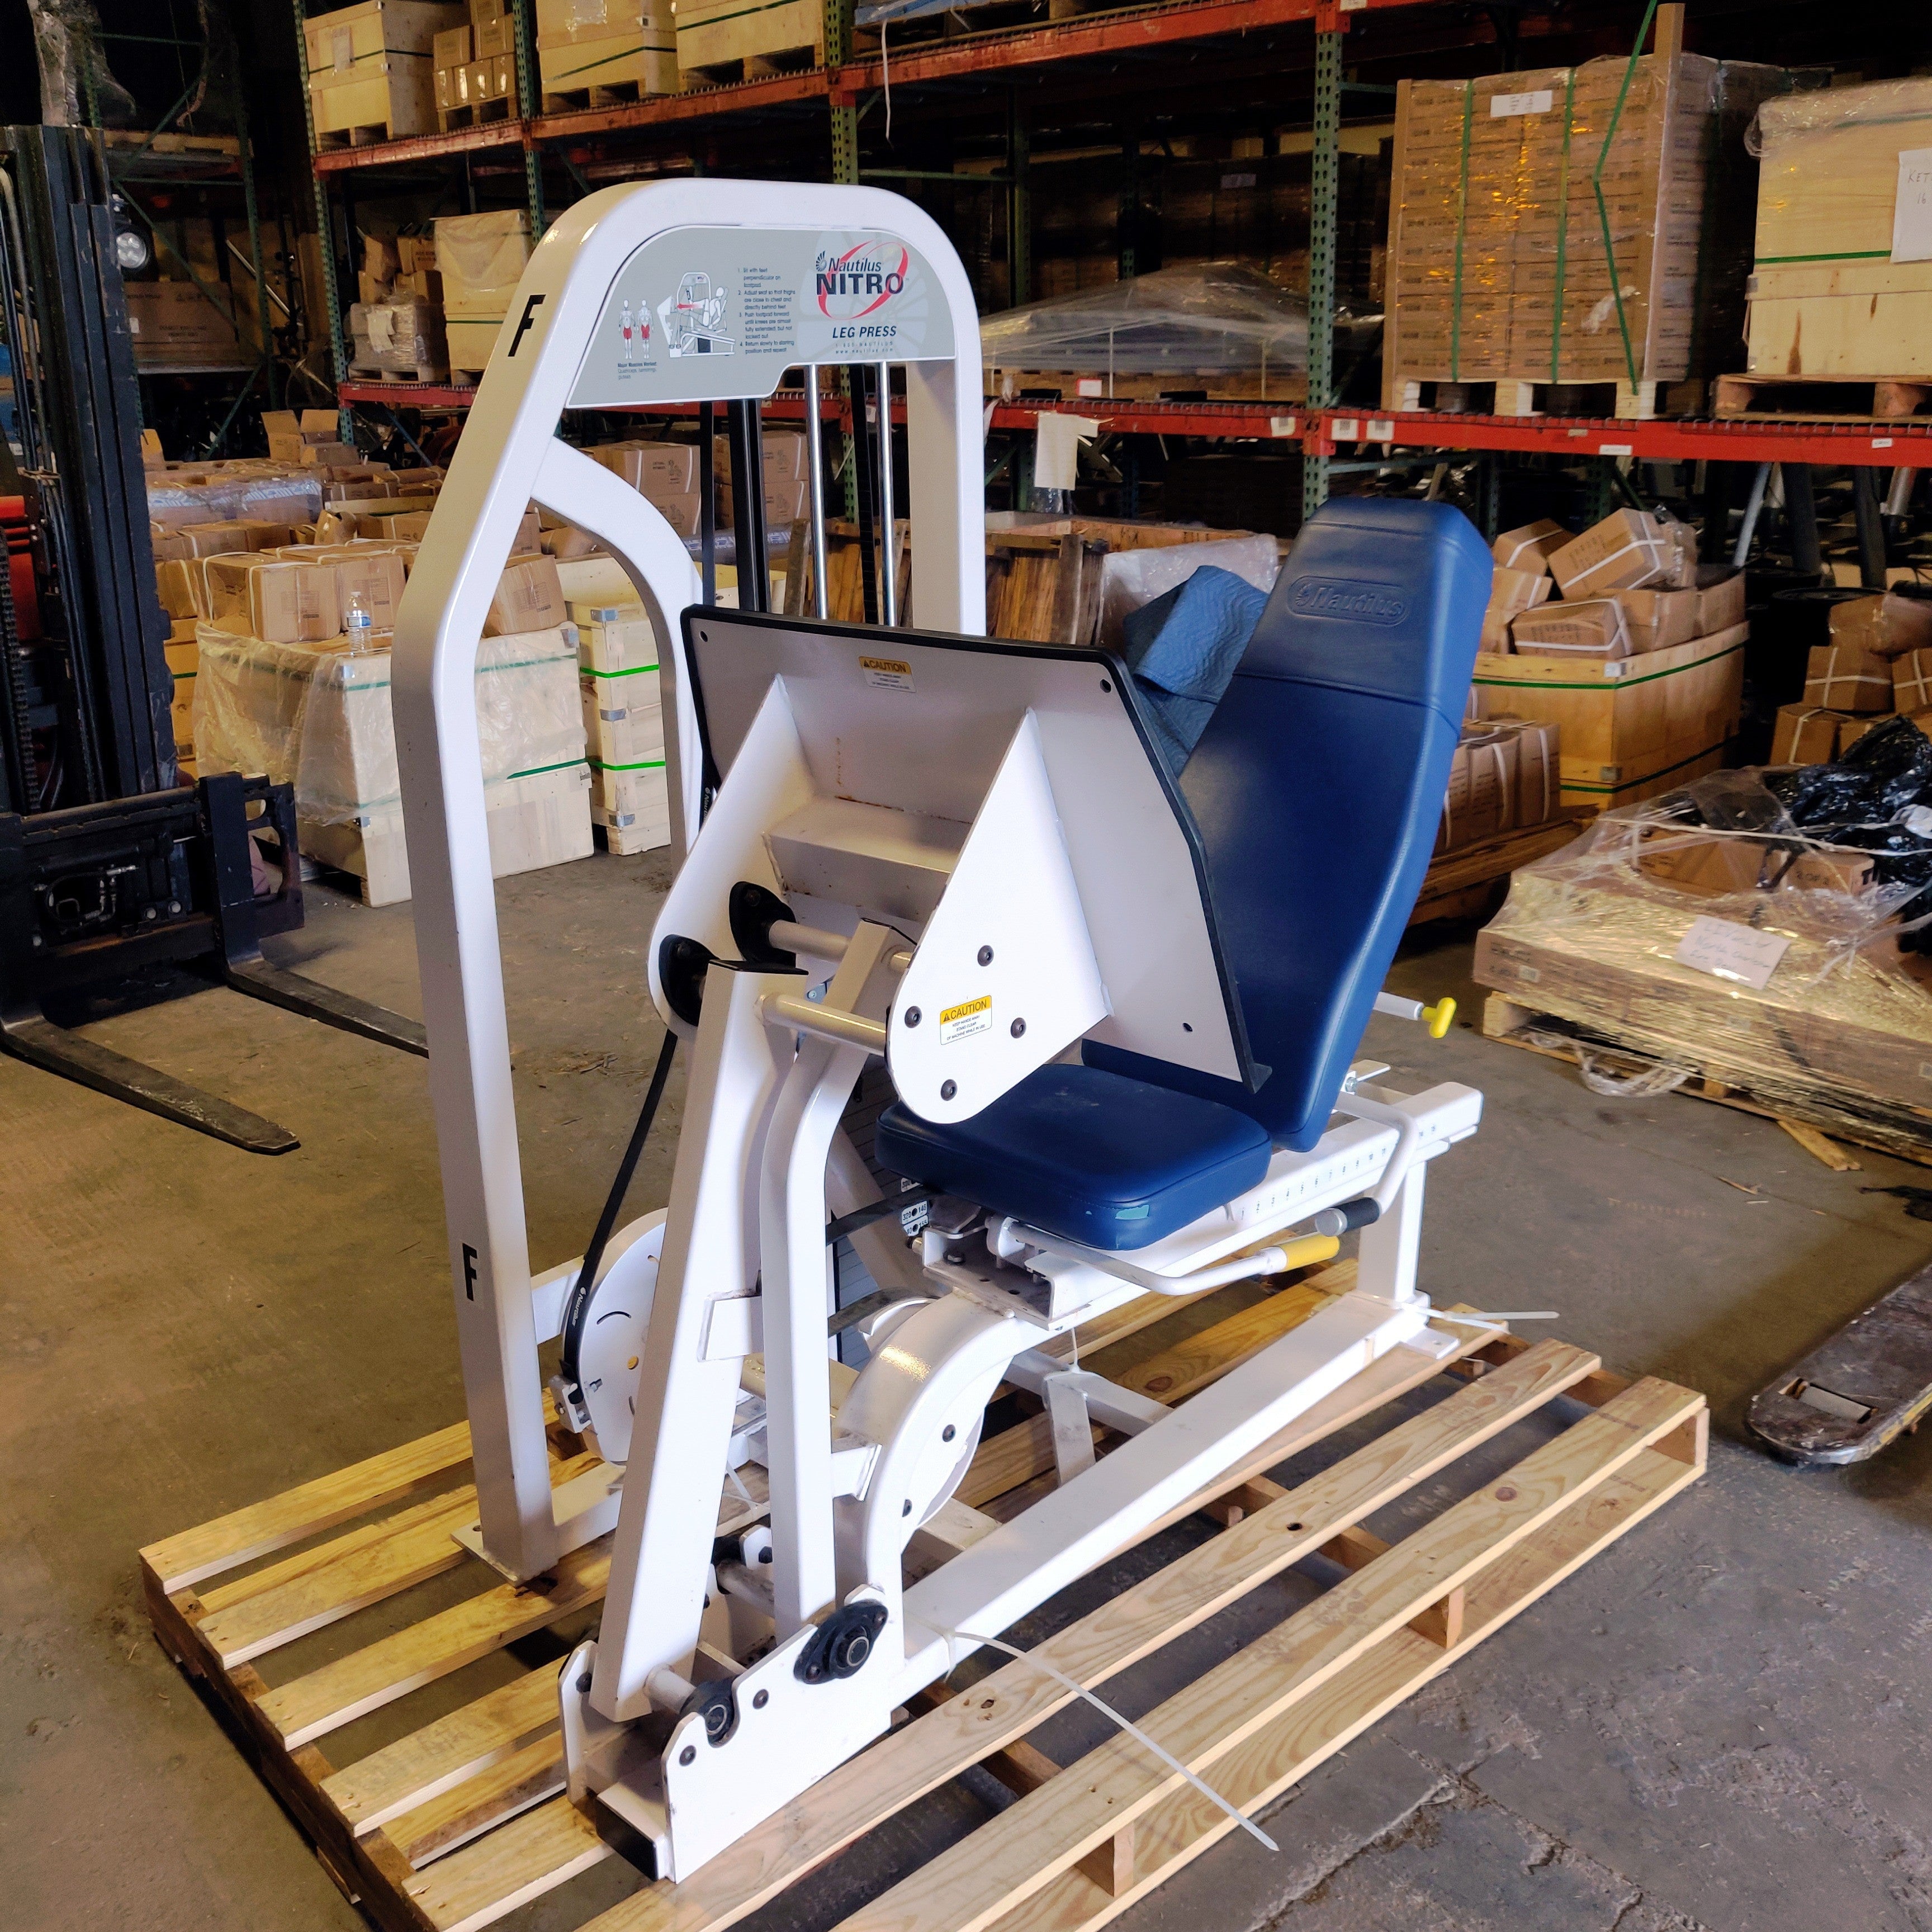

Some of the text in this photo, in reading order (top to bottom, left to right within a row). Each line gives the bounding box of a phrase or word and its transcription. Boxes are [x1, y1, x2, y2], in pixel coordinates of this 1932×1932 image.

[1908, 169, 1932, 183] KET
[828, 257, 882, 272] Nautilus
[817, 273, 903, 295] NITRO
[832, 325, 897, 338] LEG PRESS
[1311, 587, 1402, 617] Nautilus
[869, 660, 906, 673] CAUTION
[951, 999, 987, 1020] CAUTION
[903, 1211, 911, 1220] 320
